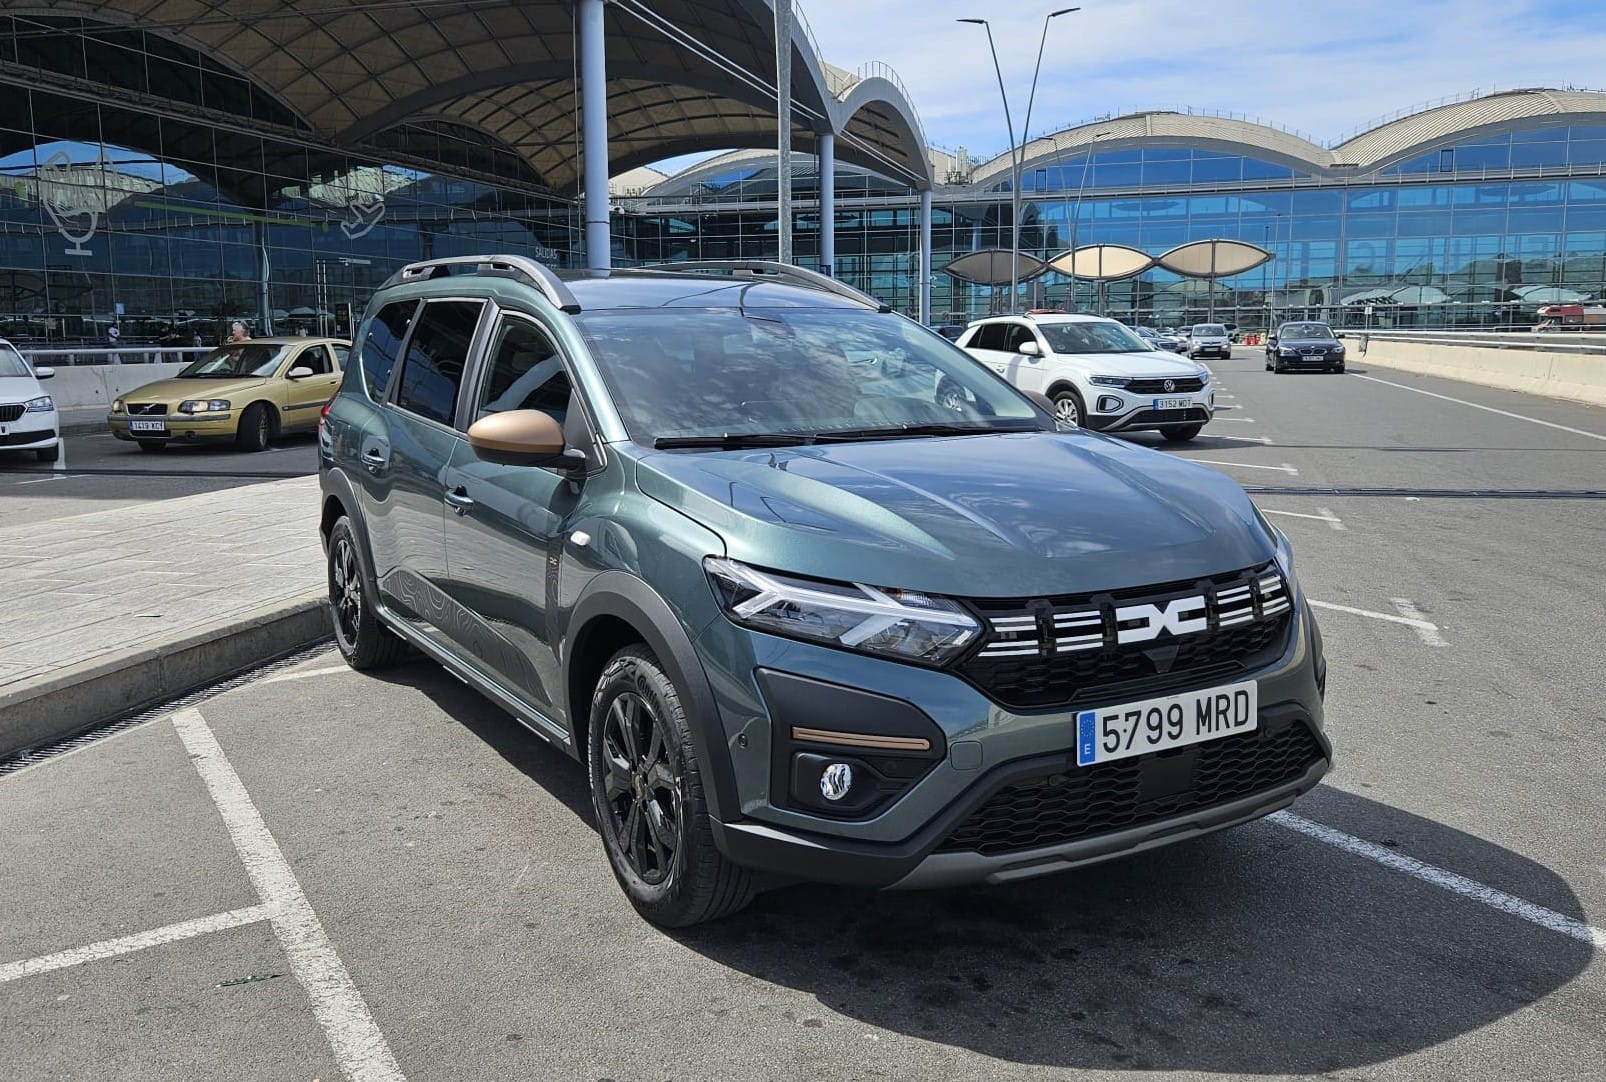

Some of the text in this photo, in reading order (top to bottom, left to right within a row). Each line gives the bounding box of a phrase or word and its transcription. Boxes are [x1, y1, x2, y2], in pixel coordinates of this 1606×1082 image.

[1159, 400, 1176, 409] 3152
[1102, 689, 1250, 754] 5799 MRD
[1084, 743, 1091, 755] E
